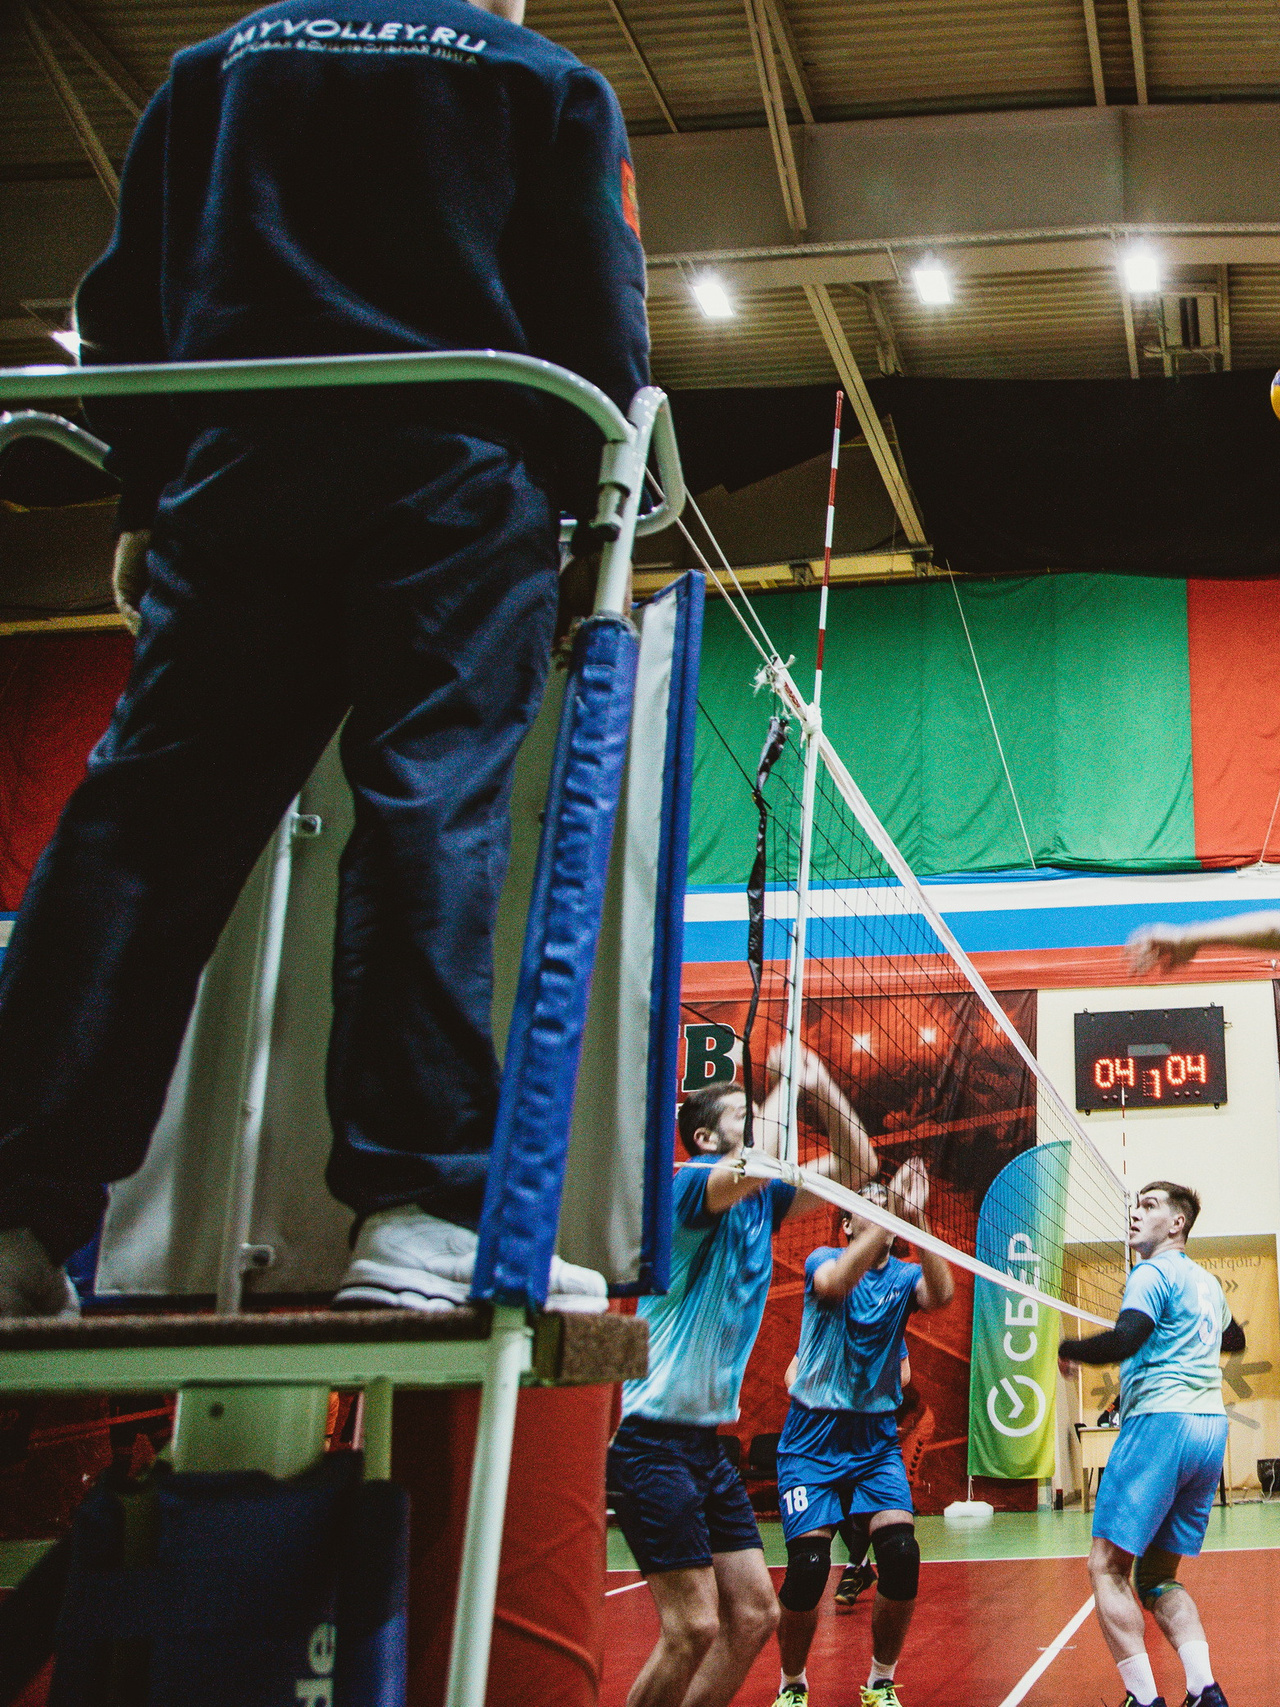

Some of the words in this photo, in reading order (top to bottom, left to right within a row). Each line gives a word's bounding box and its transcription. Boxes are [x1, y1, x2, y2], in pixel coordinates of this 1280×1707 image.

[229, 19, 487, 53] MYVOLLEY.RU
[1094, 1057, 1135, 1088] 04
[1166, 1054, 1207, 1085] 04
[783, 1485, 809, 1515] 18
